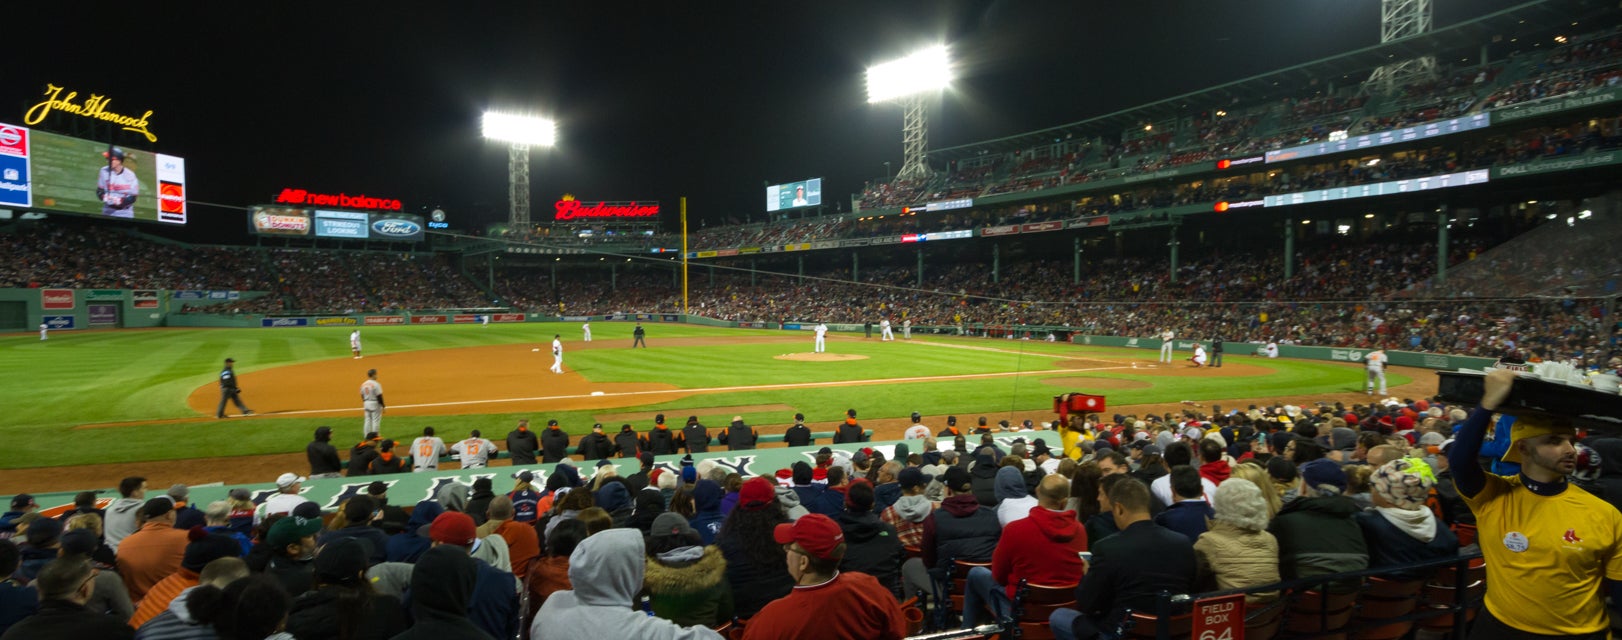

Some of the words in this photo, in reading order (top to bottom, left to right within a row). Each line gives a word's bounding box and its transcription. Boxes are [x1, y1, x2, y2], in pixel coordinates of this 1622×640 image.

[24, 83, 82, 125] John
[80, 93, 158, 142] Hancock
[1500, 165, 1527, 176] DELL
[1587, 153, 1614, 164] Level
[307, 193, 339, 206] new
[340, 193, 402, 210] balance
[554, 200, 660, 220] Budweiser
[271, 222, 306, 231] DONUTS
[322, 220, 361, 229] STRIKEOUT
[326, 227, 358, 235] LOOKING
[381, 221, 413, 235] Ford
[419, 445, 433, 457] 10
[467, 444, 479, 455] 13
[1201, 602, 1235, 615] FIELD
[1205, 613, 1229, 625] BOX
[1199, 626, 1234, 640] 64
